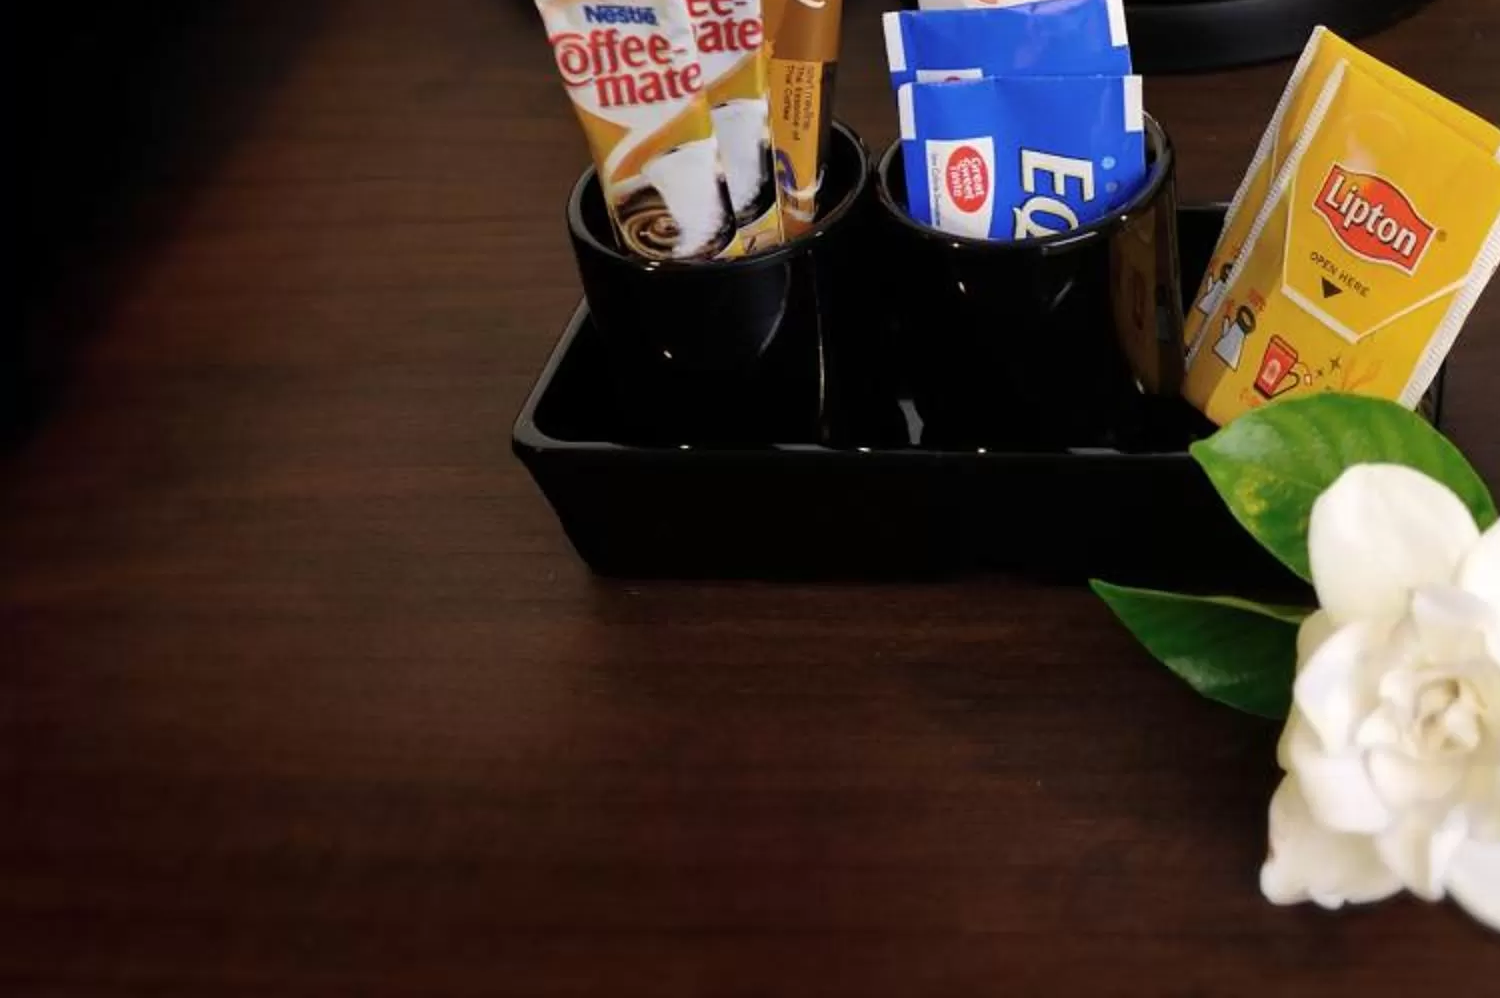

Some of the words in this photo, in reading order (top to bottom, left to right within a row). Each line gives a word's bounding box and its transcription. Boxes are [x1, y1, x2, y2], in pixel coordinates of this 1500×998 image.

[691, 16, 763, 52] ate
[594, 62, 703, 108] mate
[960, 157, 975, 199] Sweet
[971, 156, 985, 195] Great
[1324, 173, 1418, 258] Lipton
[1310, 251, 1339, 275] OPEN
[1338, 269, 1371, 298] HERE
